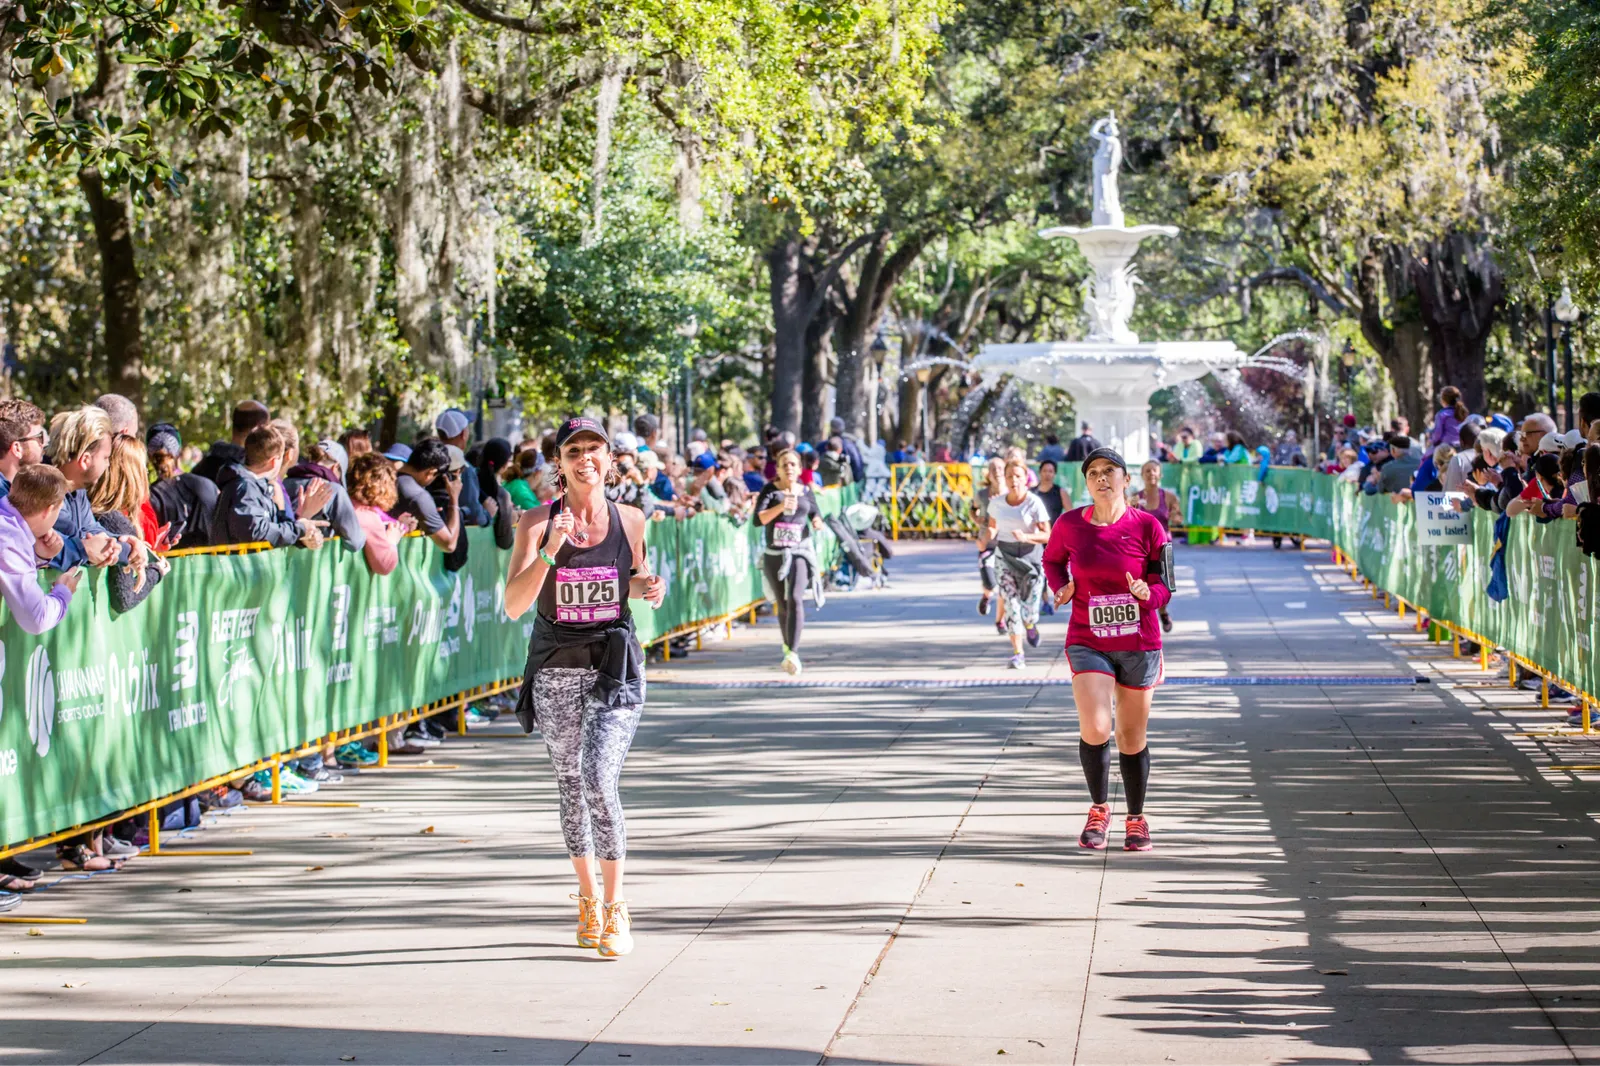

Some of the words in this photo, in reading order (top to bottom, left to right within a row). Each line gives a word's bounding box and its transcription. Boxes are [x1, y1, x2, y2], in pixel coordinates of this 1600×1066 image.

[1428, 510, 1433, 520] It
[1438, 511, 1460, 520] makes
[1428, 529, 1441, 538] you
[1445, 524, 1468, 536] faster!
[560, 580, 615, 605] 0125
[1092, 604, 1136, 624] 0966
